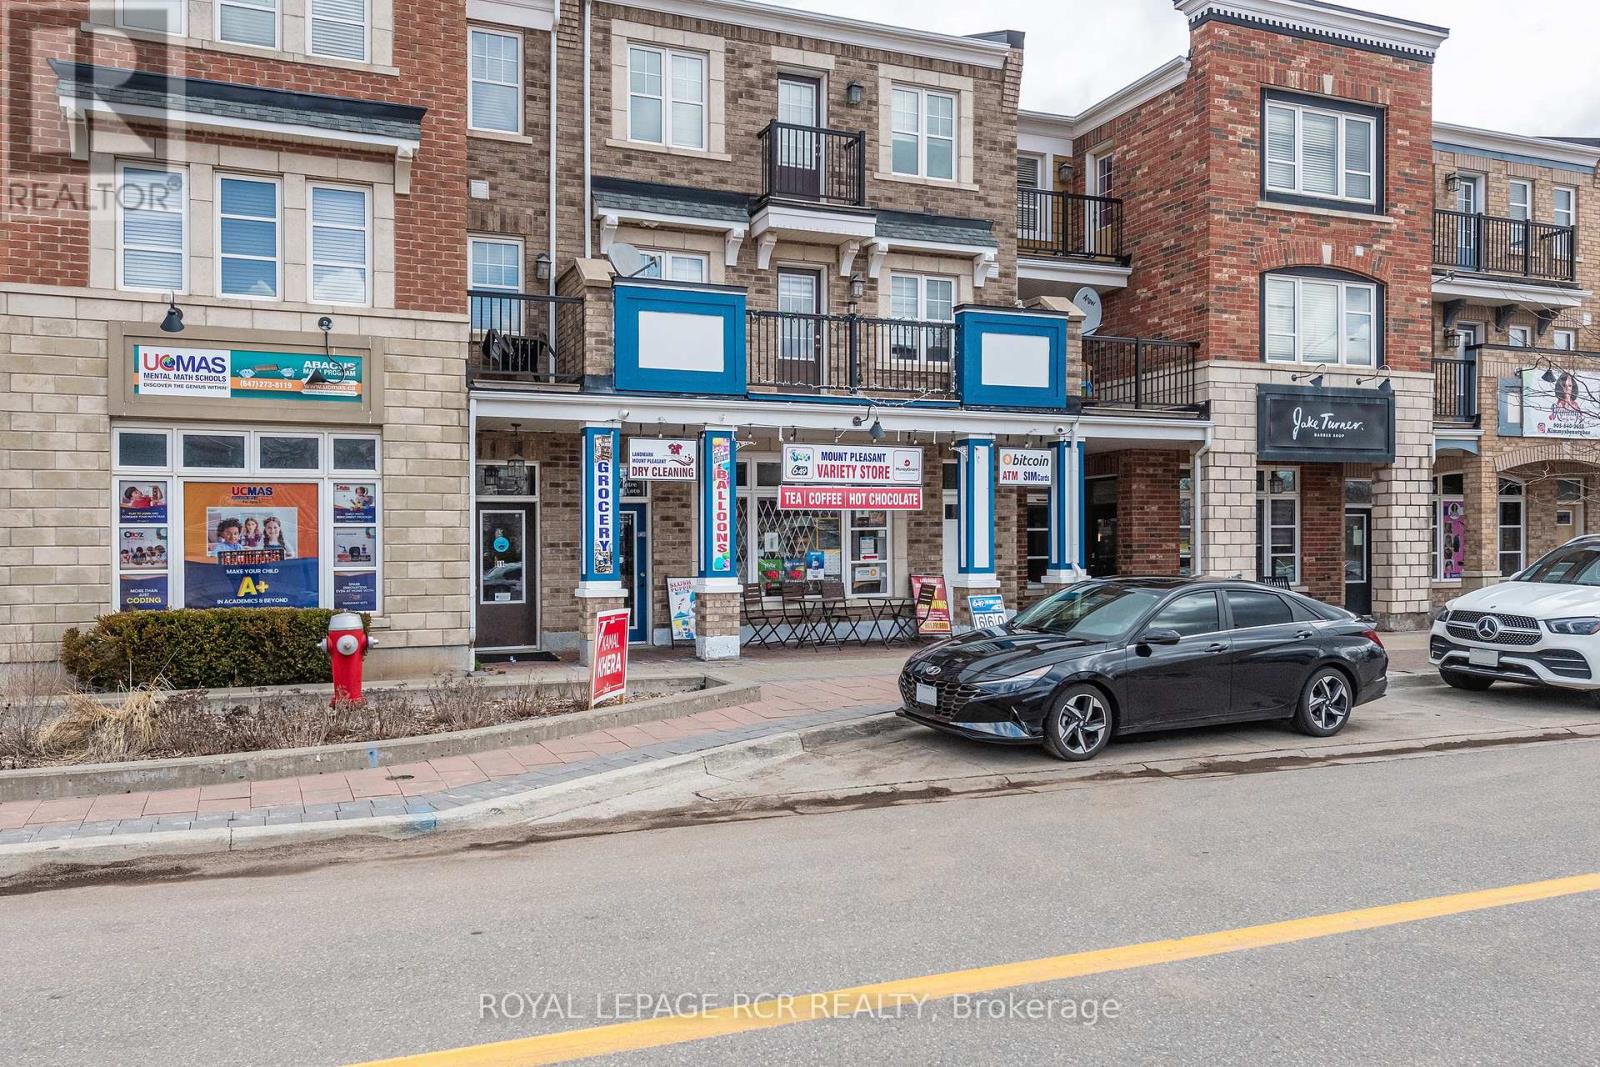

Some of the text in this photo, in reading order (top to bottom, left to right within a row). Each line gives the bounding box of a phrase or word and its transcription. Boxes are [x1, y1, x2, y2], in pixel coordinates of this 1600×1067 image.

[143, 353, 226, 374] UCMAS
[1292, 406, 1319, 440] Jake
[821, 451, 848, 461] MOUNT
[850, 452, 887, 463] PLEASANT
[1012, 454, 1049, 467] bitcoin
[631, 466, 694, 478] DRY CLEANING
[817, 463, 890, 479] VARIETY STORE
[1002, 470, 1019, 481] ATM
[1023, 471, 1037, 481] SIM
[231, 486, 273, 496] UCMAS
[784, 491, 918, 506] TEA COFFEE HOT CHOCOLATE
[597, 461, 610, 551] GROCERY
[716, 469, 728, 553] BALLOONS
[237, 576, 269, 597] A+
[598, 652, 622, 679] KHERA
